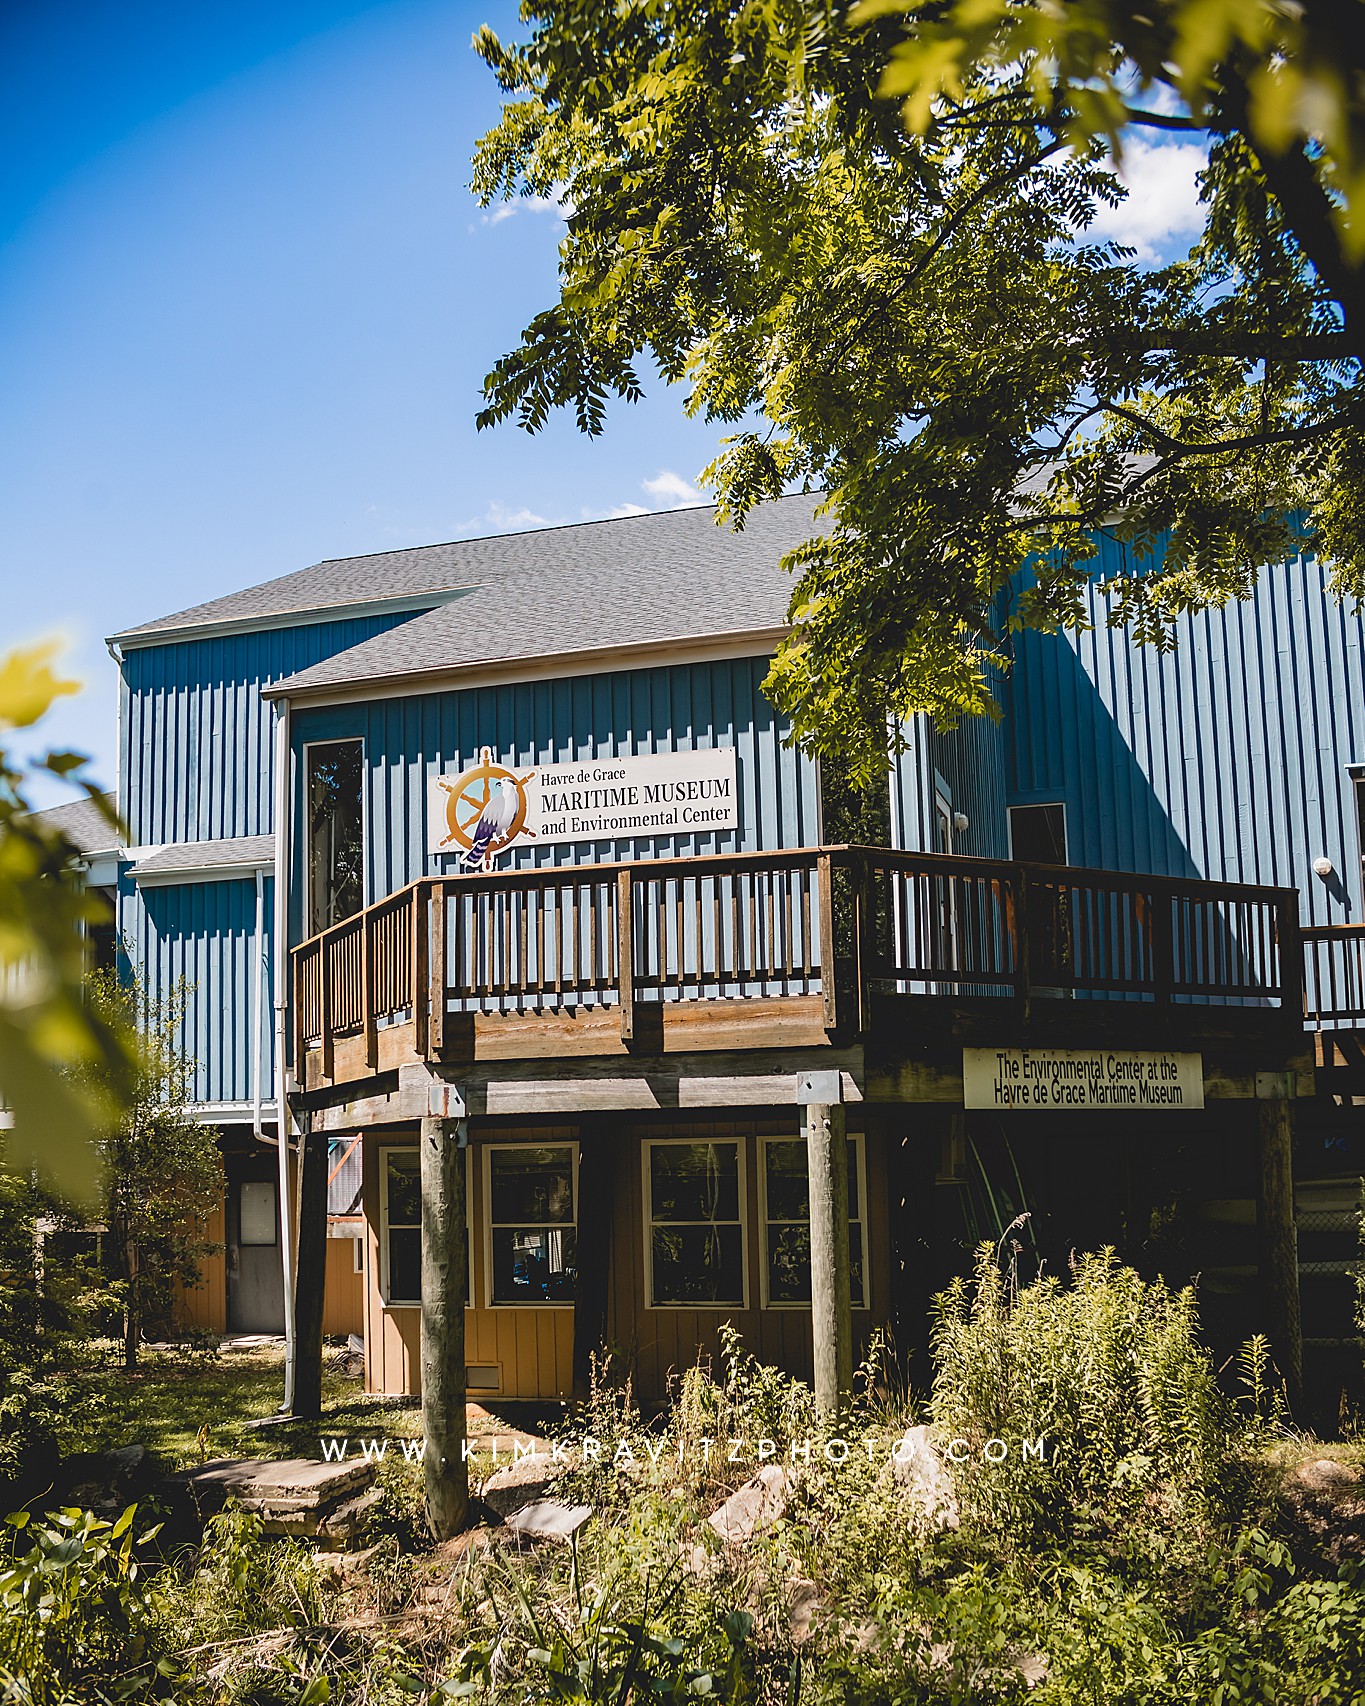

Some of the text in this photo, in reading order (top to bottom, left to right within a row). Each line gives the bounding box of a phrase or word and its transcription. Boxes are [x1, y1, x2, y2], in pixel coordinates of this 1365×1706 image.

[541, 767, 626, 787] Havre de Grace
[541, 778, 731, 813] MARITIME MUSEUM
[541, 808, 731, 836] and Environmental Center
[996, 1053, 1178, 1080] The Environmental Center at the
[994, 1078, 1183, 1104] Havre de Grace Maritime Museum
